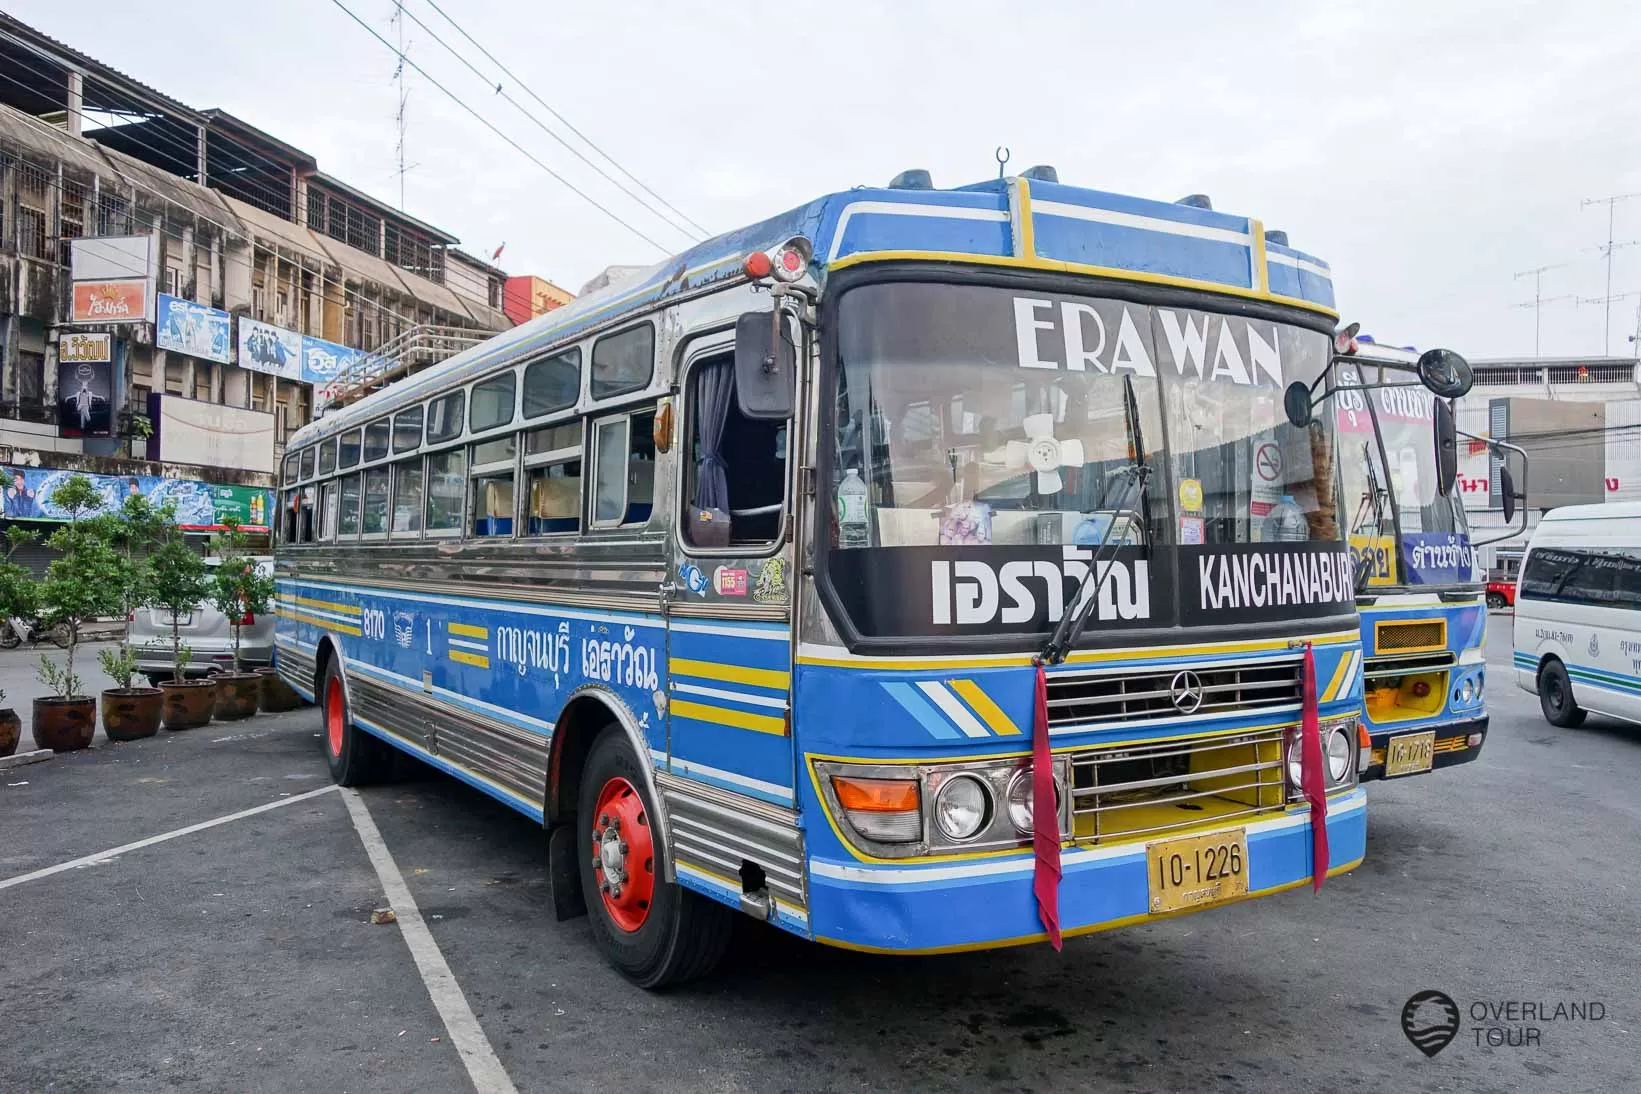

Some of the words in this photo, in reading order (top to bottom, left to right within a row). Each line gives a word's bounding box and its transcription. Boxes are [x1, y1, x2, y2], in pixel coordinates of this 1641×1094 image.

[1013, 297, 1284, 388] ERAWAN
[1200, 553, 1355, 609] KANCHANABURI
[1412, 535, 1472, 569] ด่านช้าง
[932, 545, 1150, 625] เอราวัณ
[497, 621, 570, 690] กาญจนบุรี
[1159, 843, 1241, 889] 10-1226
